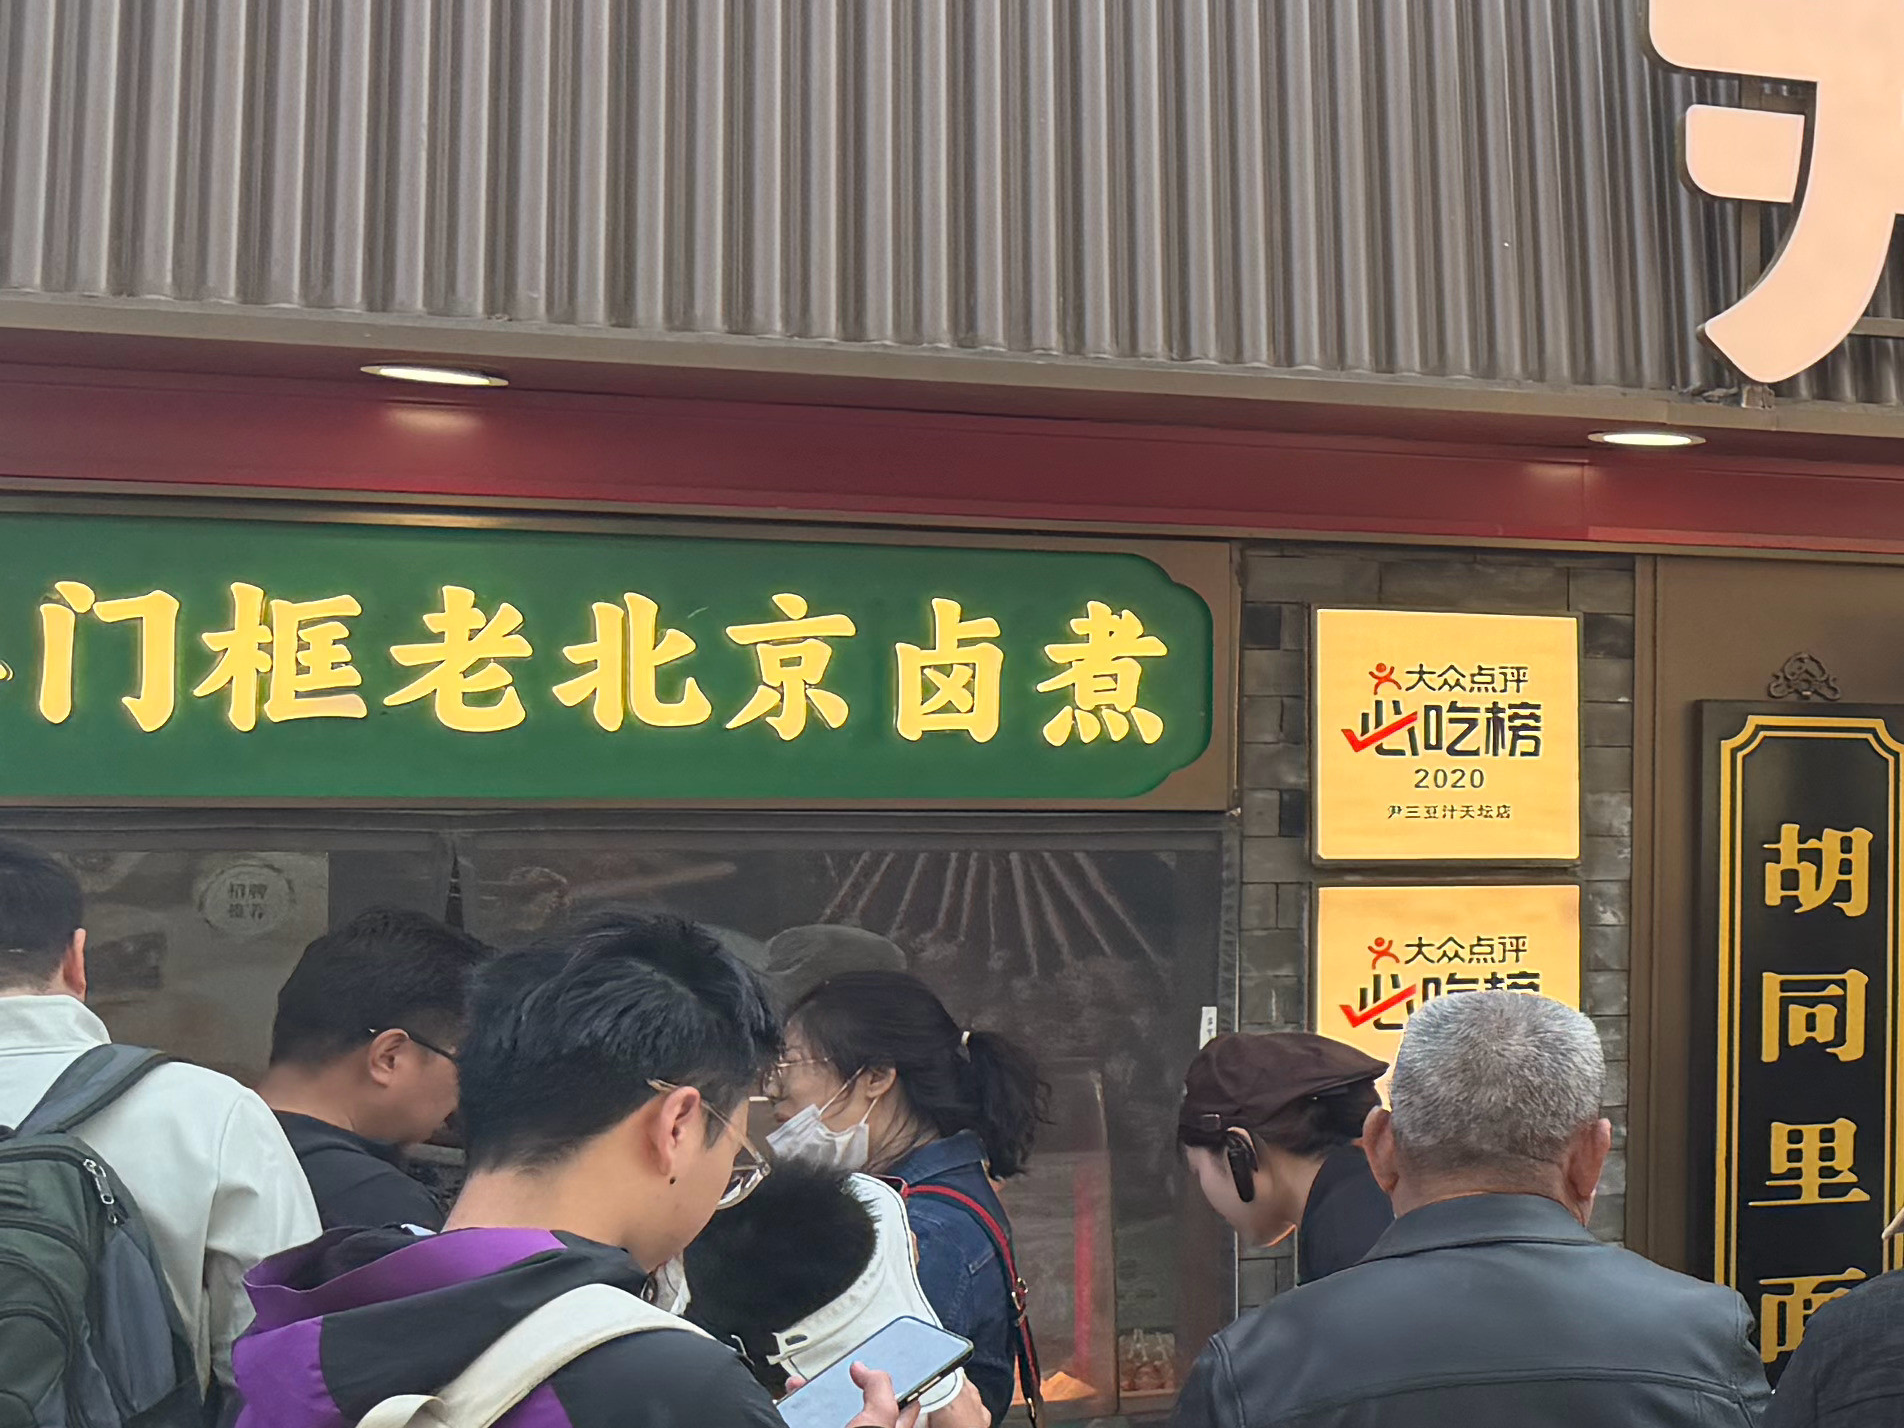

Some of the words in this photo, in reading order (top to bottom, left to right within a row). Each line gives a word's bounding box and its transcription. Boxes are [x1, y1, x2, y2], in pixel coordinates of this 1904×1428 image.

[0, 580, 1169, 747] 门框老北京卤煮
[1405, 663, 1529, 693] 大众点评
[1341, 698, 1542, 758] 必吃榜
[1414, 768, 1485, 789] 2020
[1387, 804, 1512, 820] 尹三豆汁天坛店
[1404, 935, 1528, 965] 大众点评
